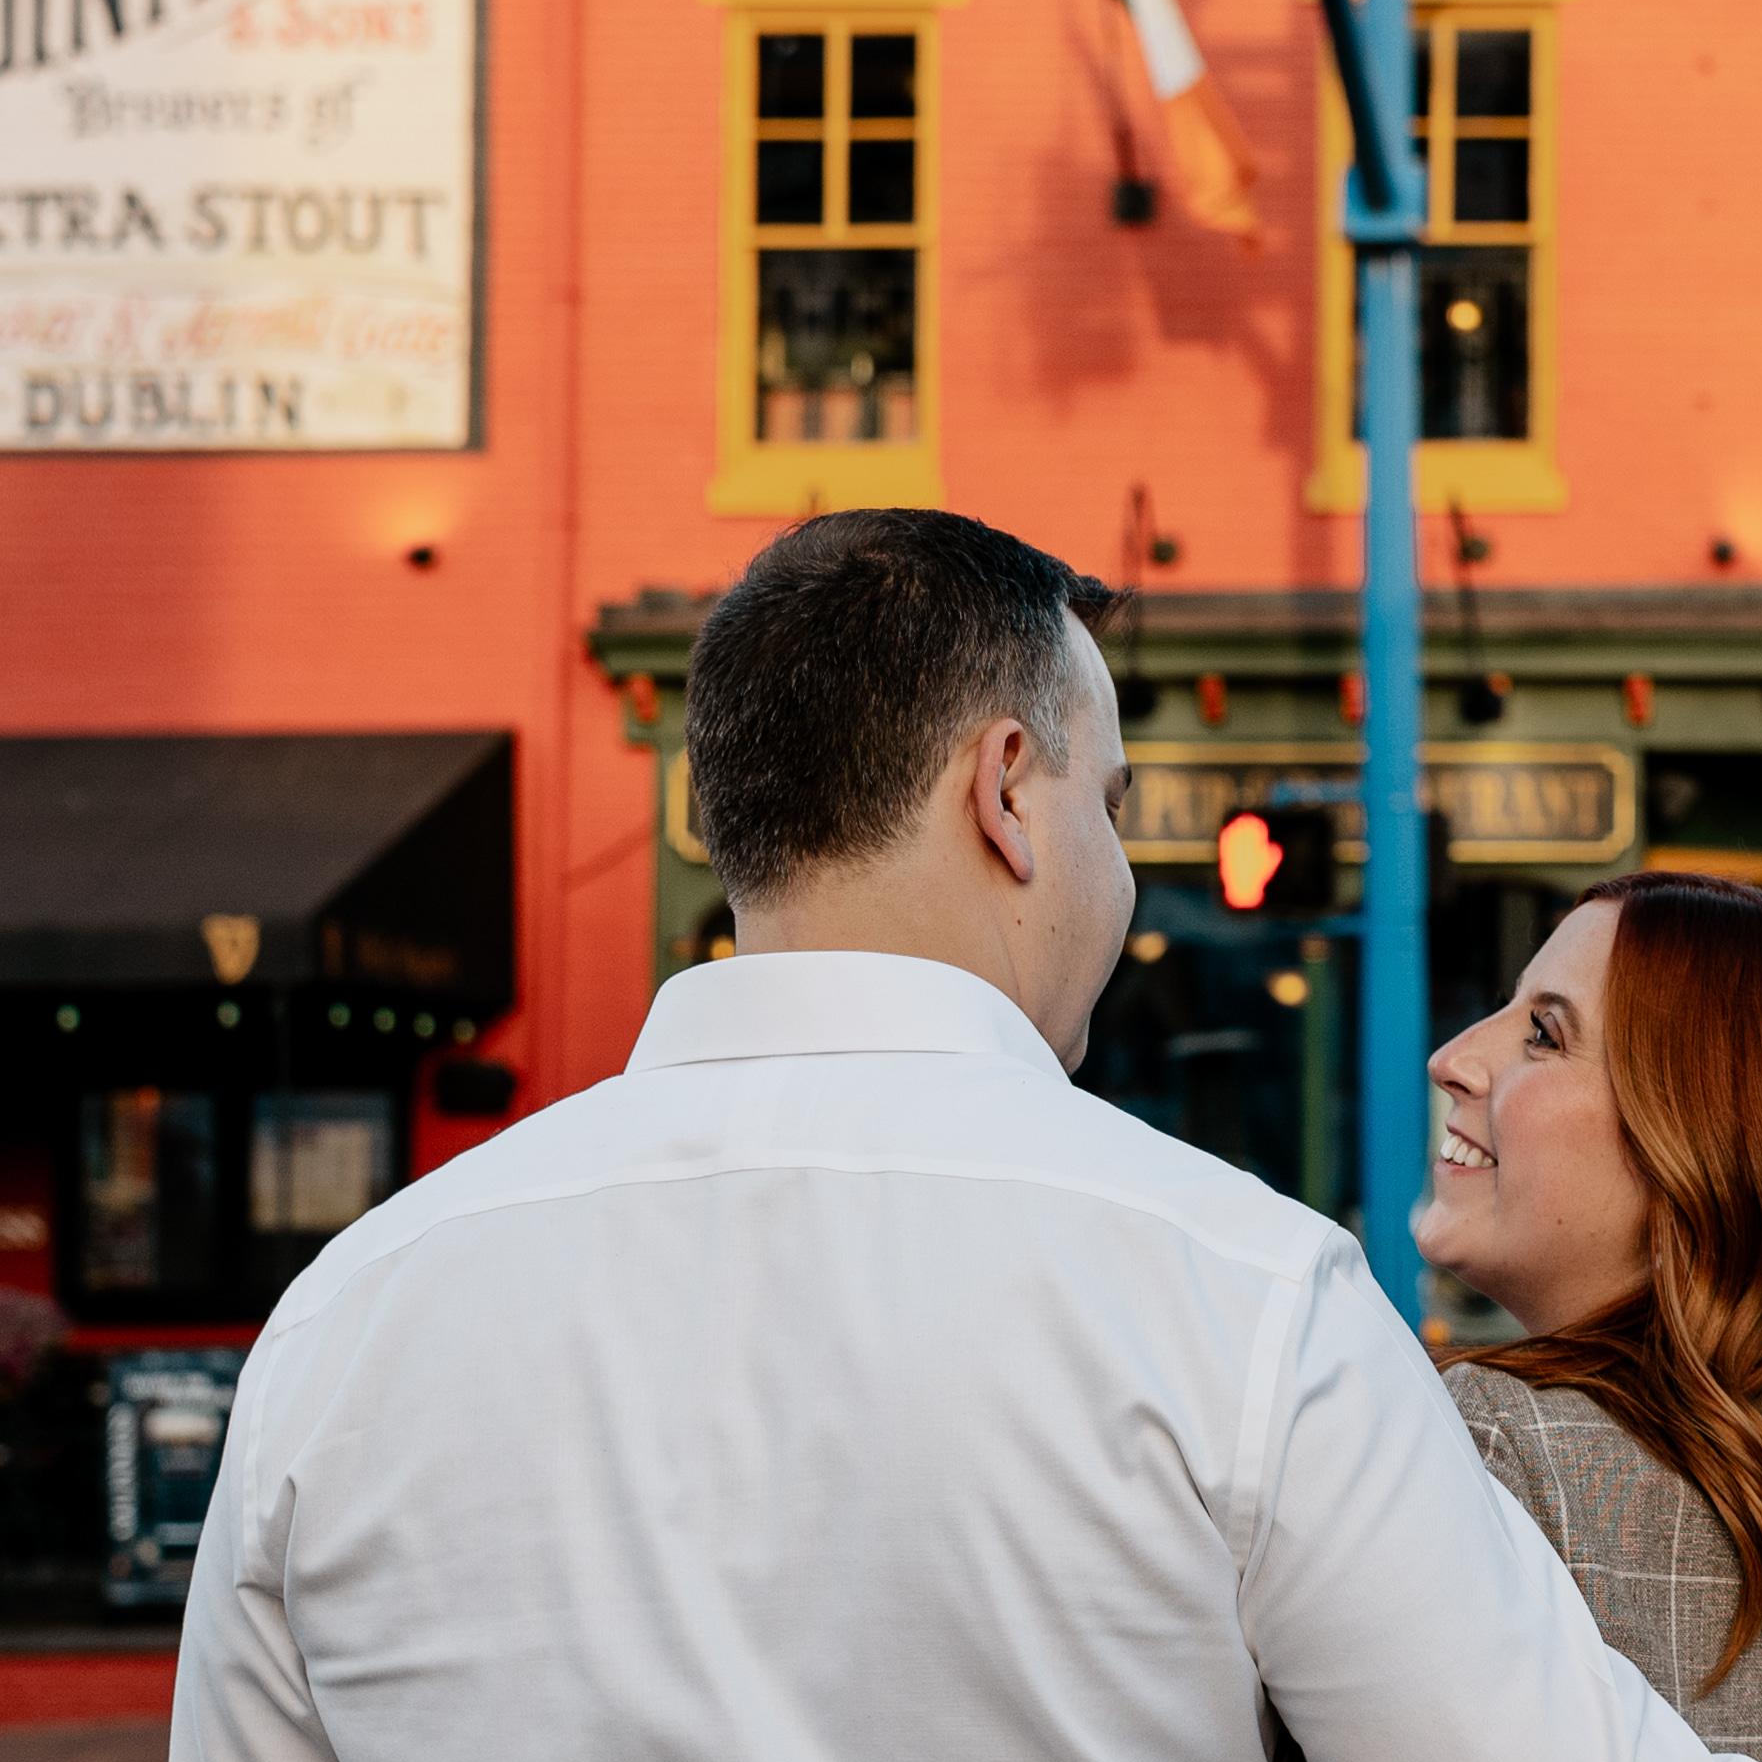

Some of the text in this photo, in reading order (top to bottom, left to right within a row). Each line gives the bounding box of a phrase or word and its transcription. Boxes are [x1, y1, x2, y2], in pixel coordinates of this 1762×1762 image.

[0, 186, 447, 259] TRA STOUT
[22, 365, 303, 433] DUBLIN
